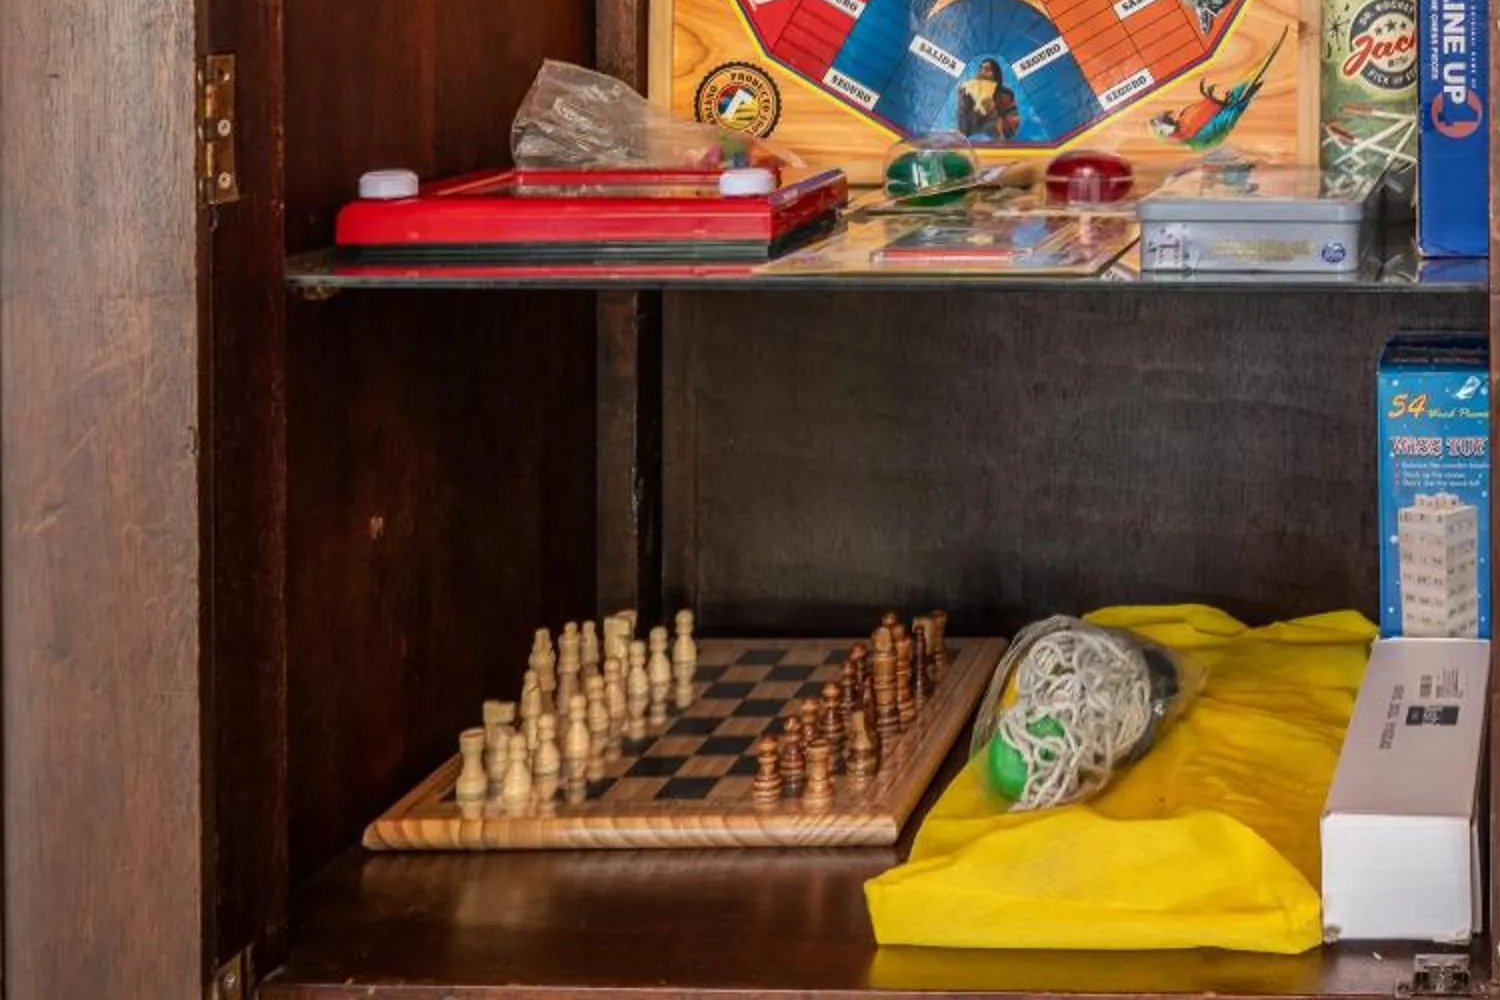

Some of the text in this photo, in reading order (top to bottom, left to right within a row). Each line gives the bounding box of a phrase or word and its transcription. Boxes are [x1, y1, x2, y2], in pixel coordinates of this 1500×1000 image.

[916, 41, 959, 73] SALIDA
[1018, 42, 1061, 74] SEGURO
[830, 73, 873, 106] SEGURO
[1104, 73, 1148, 106] SEGURO
[1443, 62, 1466, 104] UP
[1388, 393, 1427, 418] 54
